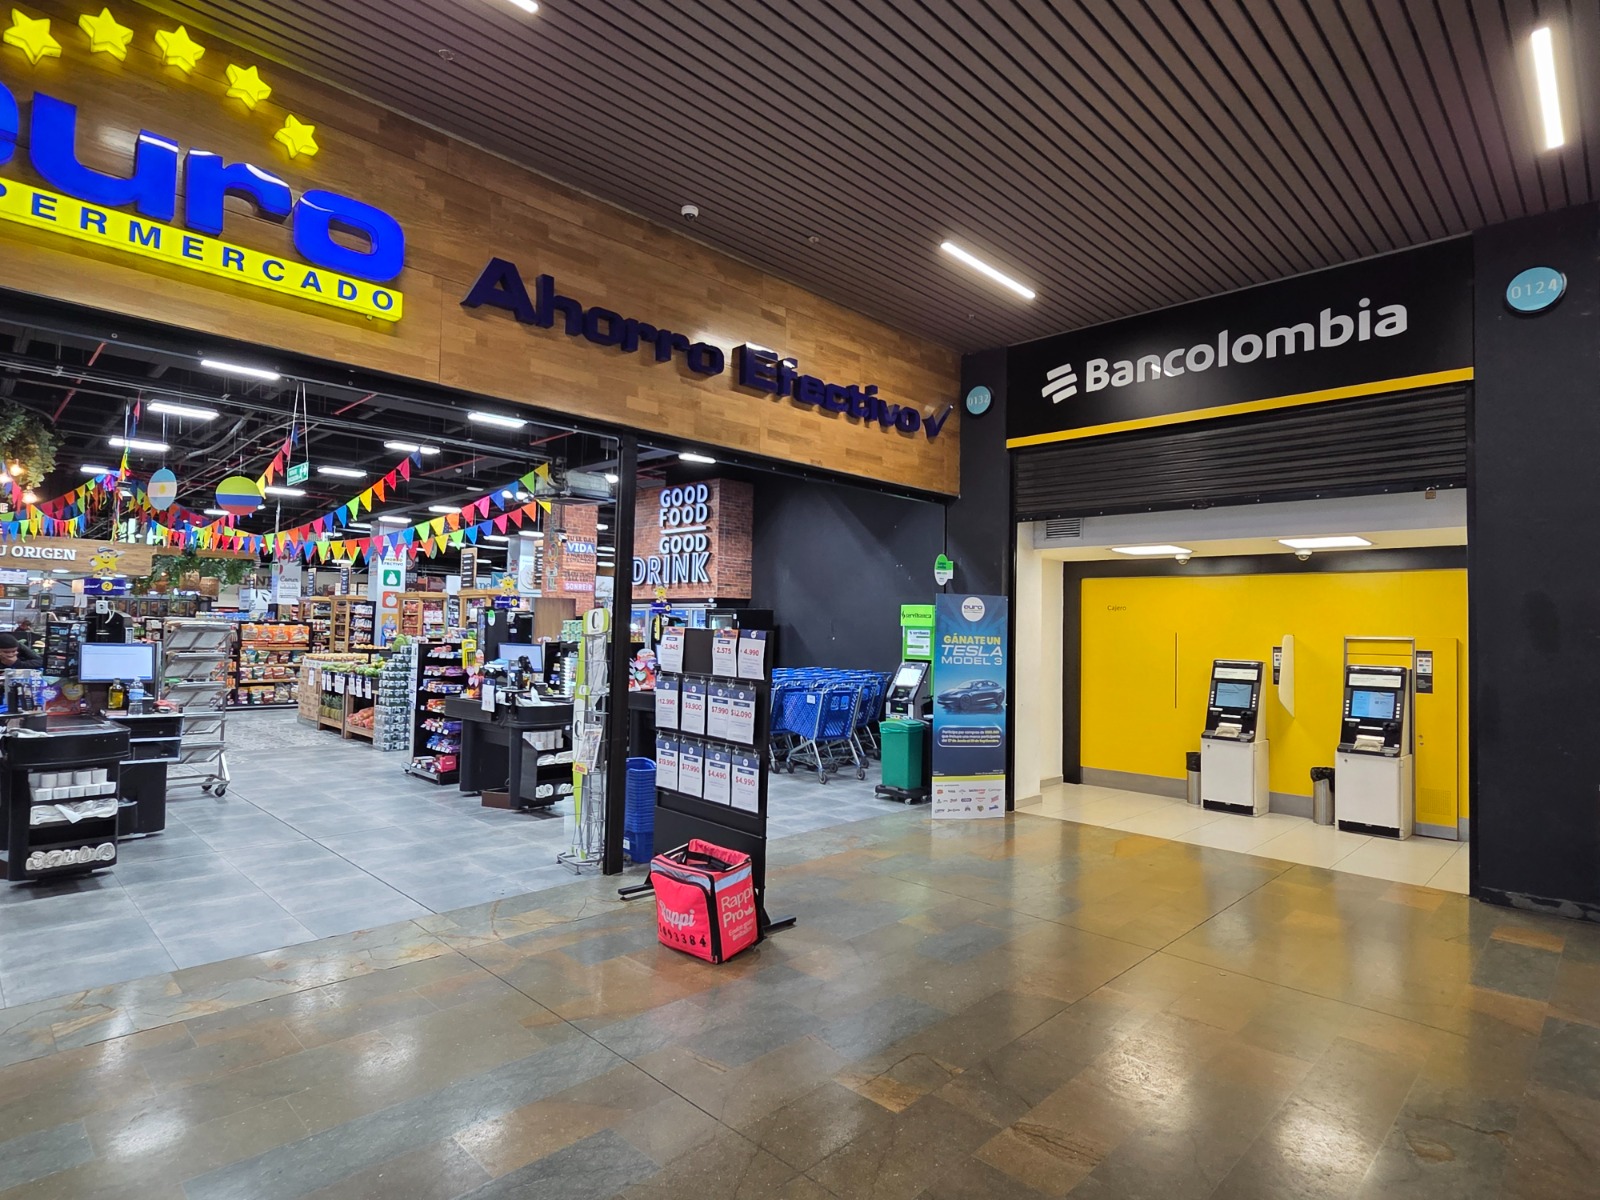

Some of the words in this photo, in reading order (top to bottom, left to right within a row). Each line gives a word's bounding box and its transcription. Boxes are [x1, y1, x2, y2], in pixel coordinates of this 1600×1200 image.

[0, 186, 394, 311] ERMERCADO
[1511, 278, 1557, 299] 0124
[460, 257, 724, 375] Ahorro
[733, 341, 921, 433] Efectivo
[1086, 297, 1408, 392] Bancolombia
[660, 484, 708, 508] GOOD
[659, 503, 708, 528] FOOD
[11, 545, 77, 560] ORIGEN
[567, 541, 594, 553] VIDA
[659, 534, 707, 554] GOOD
[632, 552, 710, 587] DRINK
[943, 633, 986, 645] GÁNATE
[987, 636, 1001, 645] UN
[941, 645, 1003, 657] TESLA
[941, 656, 991, 665] MODEL
[994, 657, 1003, 665] 3
[721, 884, 753, 912] Rappi
[660, 900, 696, 930] Rappi
[722, 910, 744, 928] Pro
